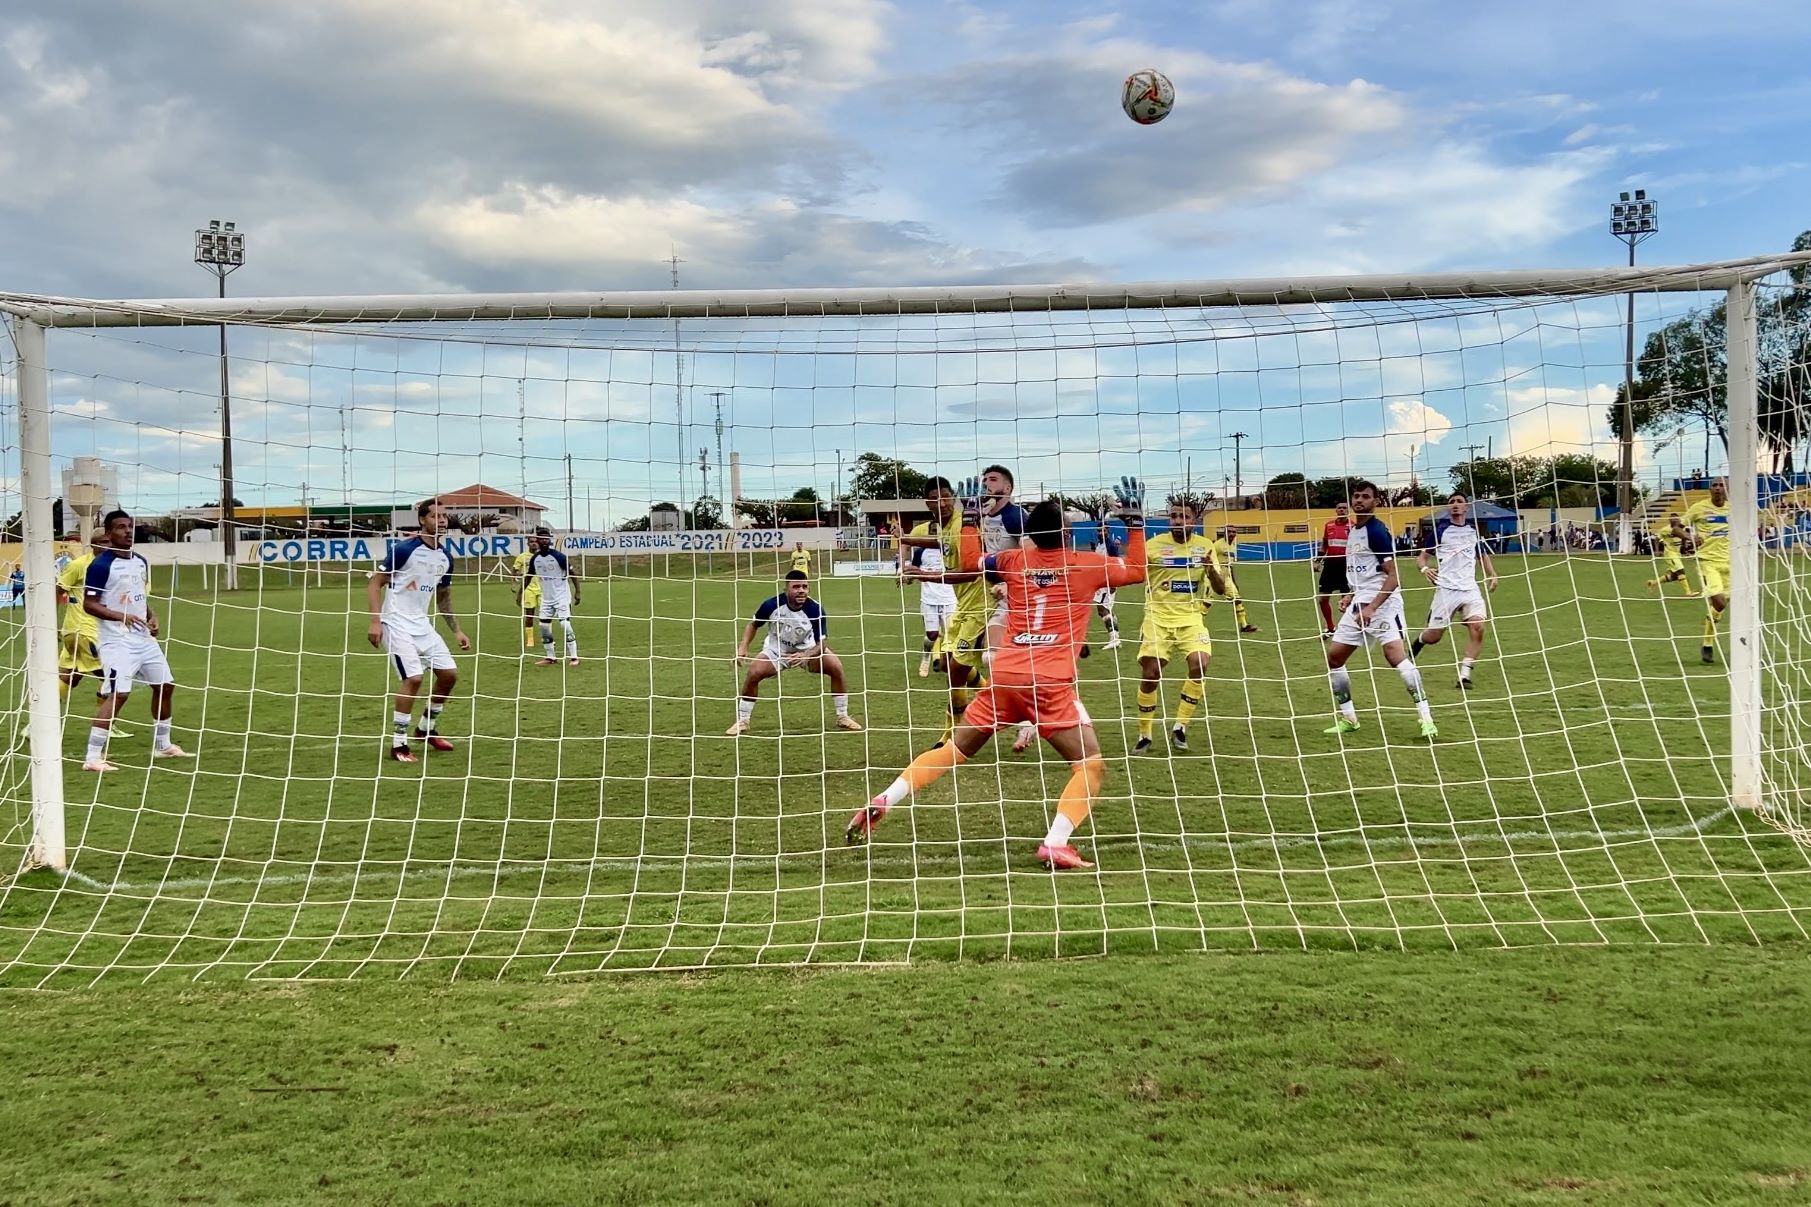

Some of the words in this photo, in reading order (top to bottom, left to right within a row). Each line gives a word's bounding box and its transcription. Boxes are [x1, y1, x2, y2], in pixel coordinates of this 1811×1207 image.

[259, 539, 371, 561] COBRA
[446, 535, 552, 556] NORT
[564, 533, 616, 549] CAMPEÃO
[619, 534, 676, 548] ESTADUAL
[681, 533, 723, 550] 2021
[741, 531, 784, 548] 2023
[1031, 594, 1048, 631] 1
